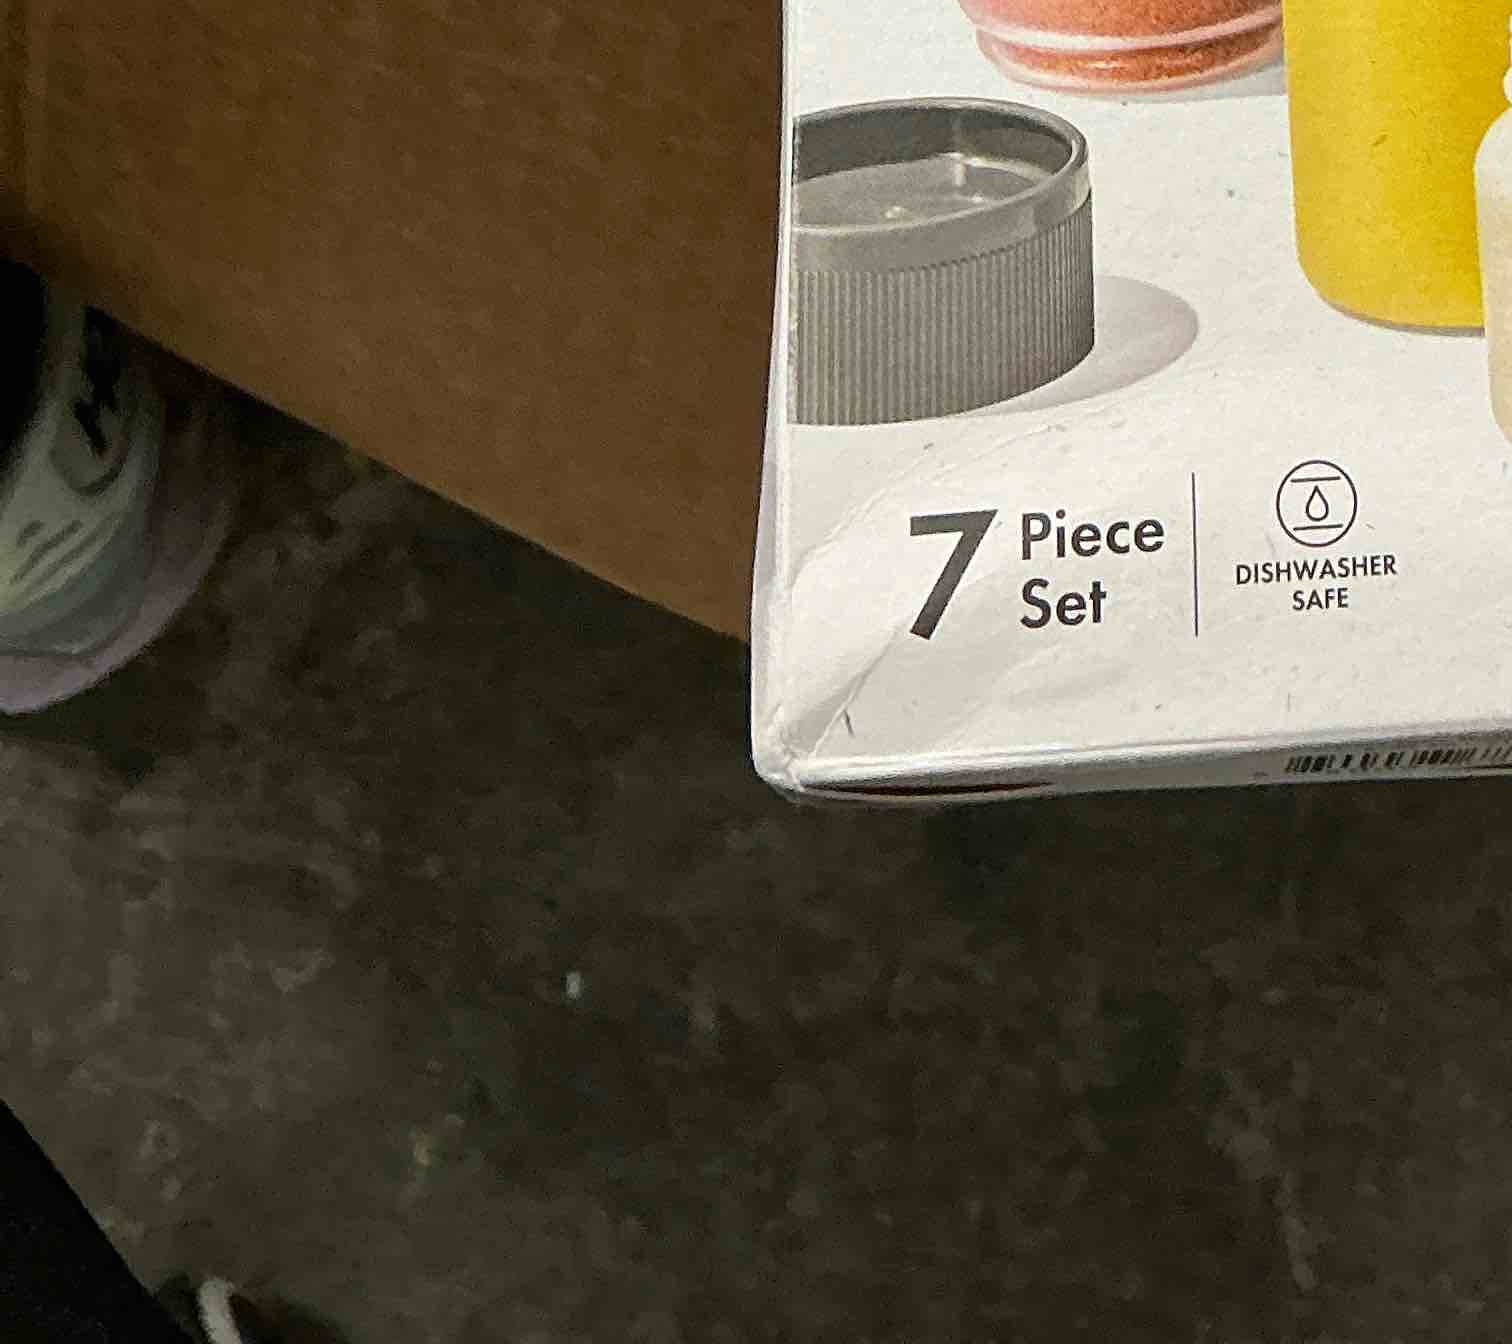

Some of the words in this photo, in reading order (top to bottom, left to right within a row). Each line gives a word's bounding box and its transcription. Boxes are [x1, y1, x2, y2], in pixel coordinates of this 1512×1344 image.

[1022, 510, 1164, 560] Piece
[910, 509, 998, 640] 7
[1237, 555, 1396, 585] DISHWASHER
[1020, 579, 1107, 628] Set
[1293, 588, 1348, 611] SAFE
